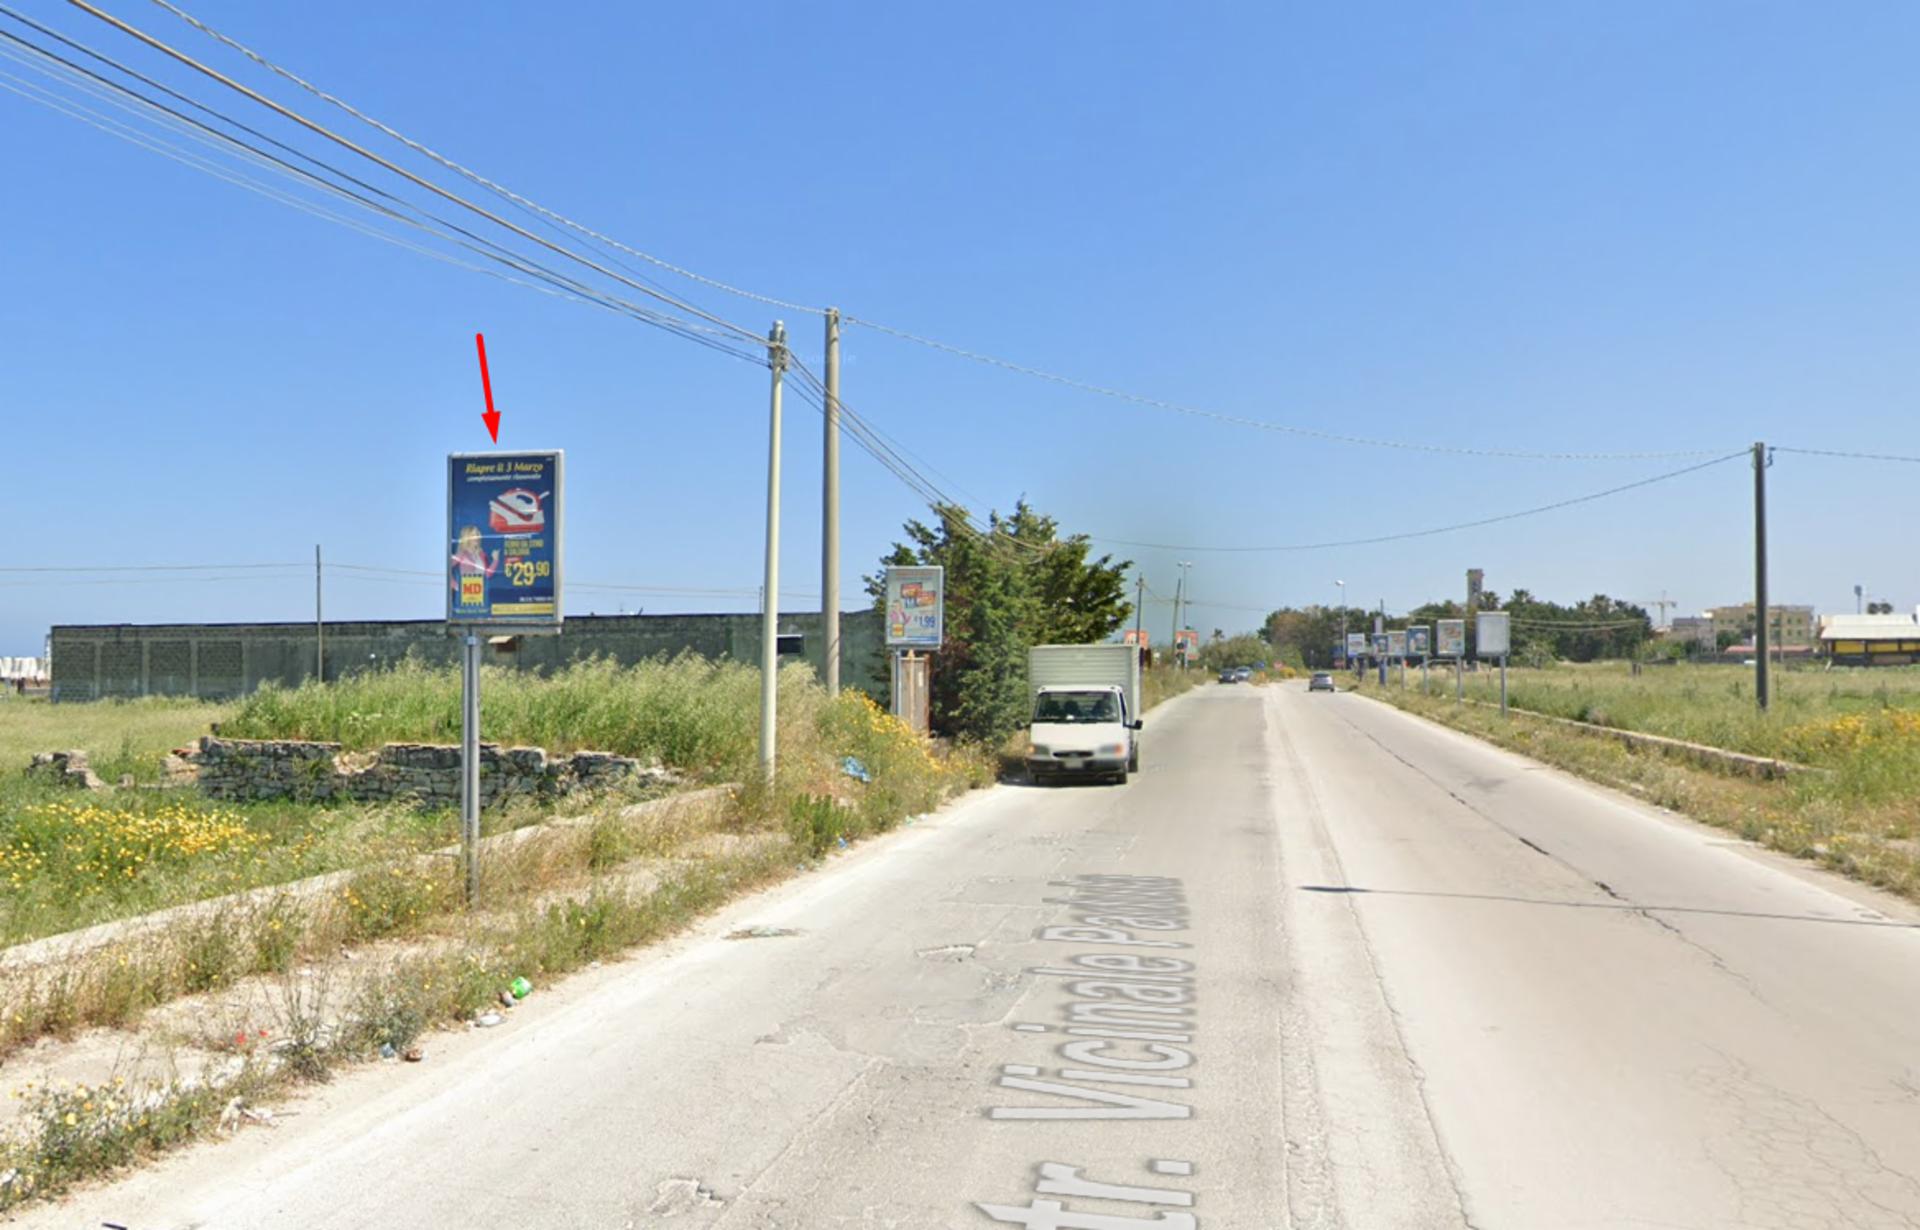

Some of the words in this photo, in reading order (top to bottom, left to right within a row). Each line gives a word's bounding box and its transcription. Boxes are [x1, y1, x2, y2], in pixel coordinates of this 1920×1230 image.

[465, 463, 495, 474] Riapre
[514, 462, 543, 472] Marzo
[463, 583, 482, 595] MD
